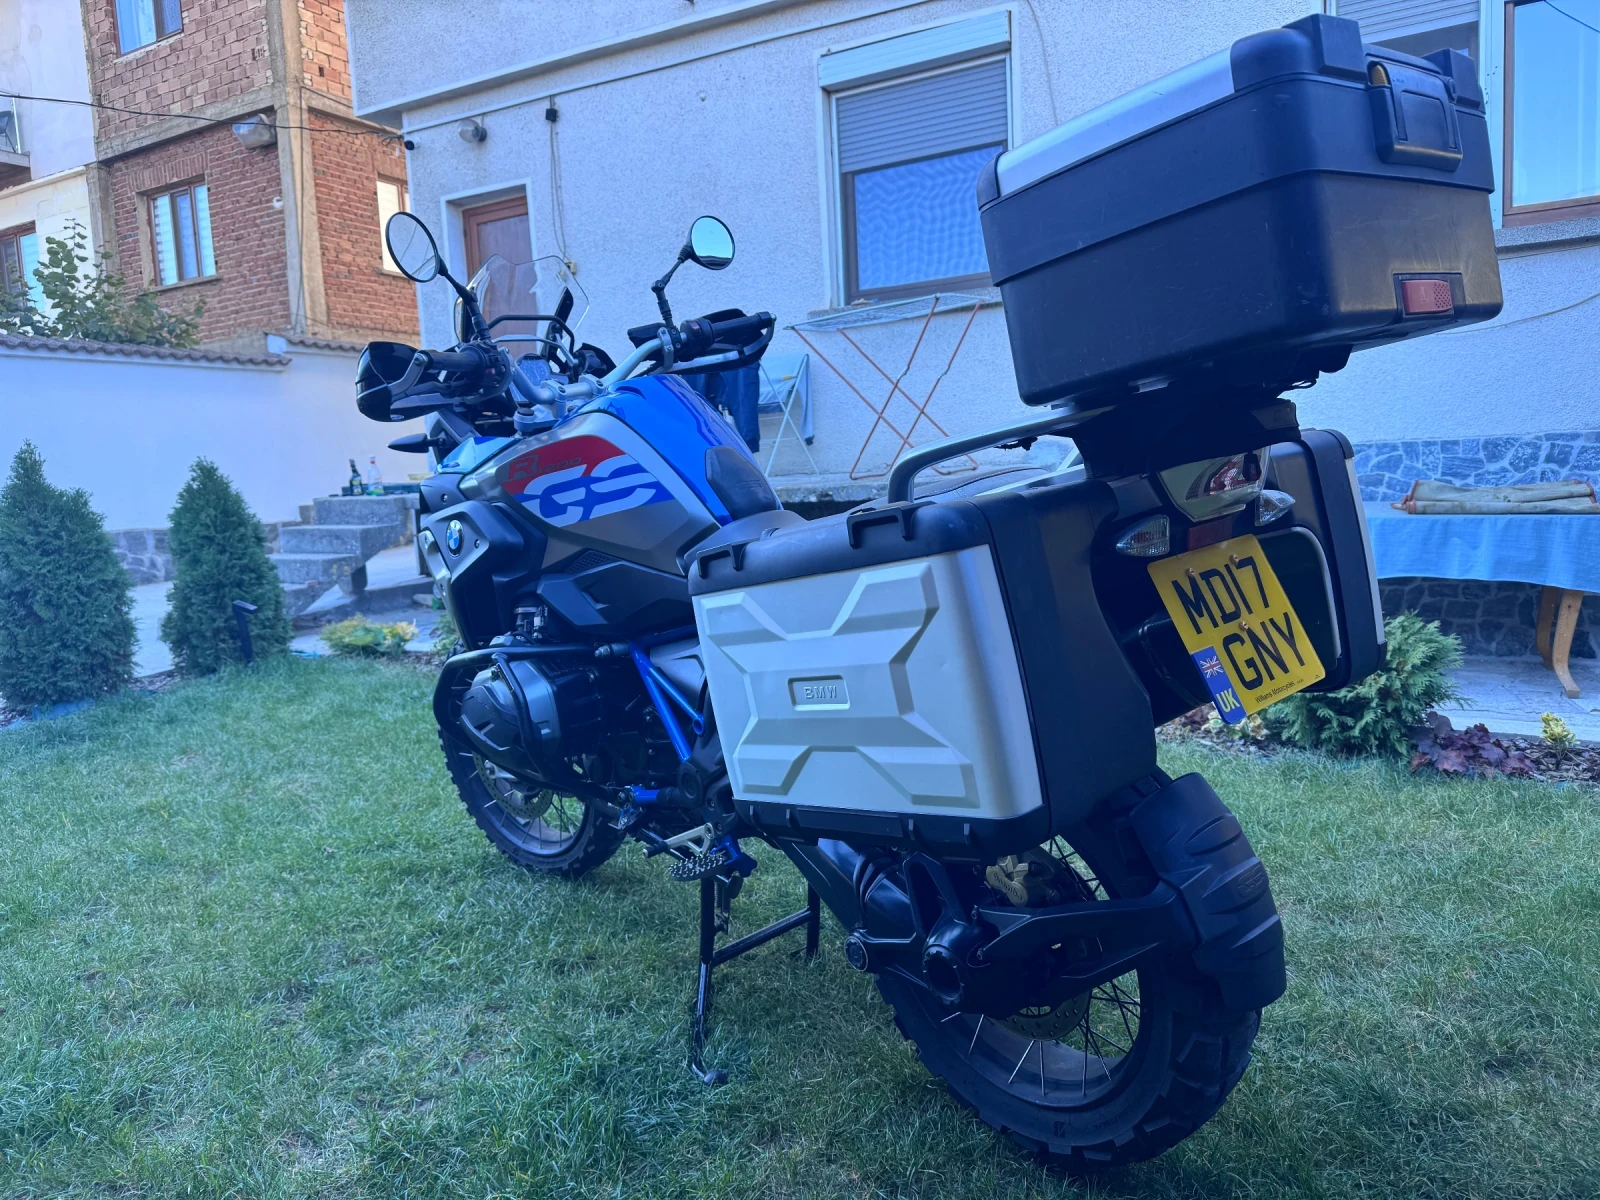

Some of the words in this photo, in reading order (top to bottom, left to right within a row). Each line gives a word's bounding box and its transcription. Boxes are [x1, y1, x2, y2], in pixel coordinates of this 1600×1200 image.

[508, 457, 537, 480] R
[520, 453, 659, 528] GS
[1171, 555, 1269, 635] MD17
[1222, 611, 1306, 691] GNY
[803, 685, 838, 700] BMW
[1215, 687, 1241, 713] UK
[1254, 690, 1273, 704] Williams
[1272, 680, 1296, 696] Motorcycles
